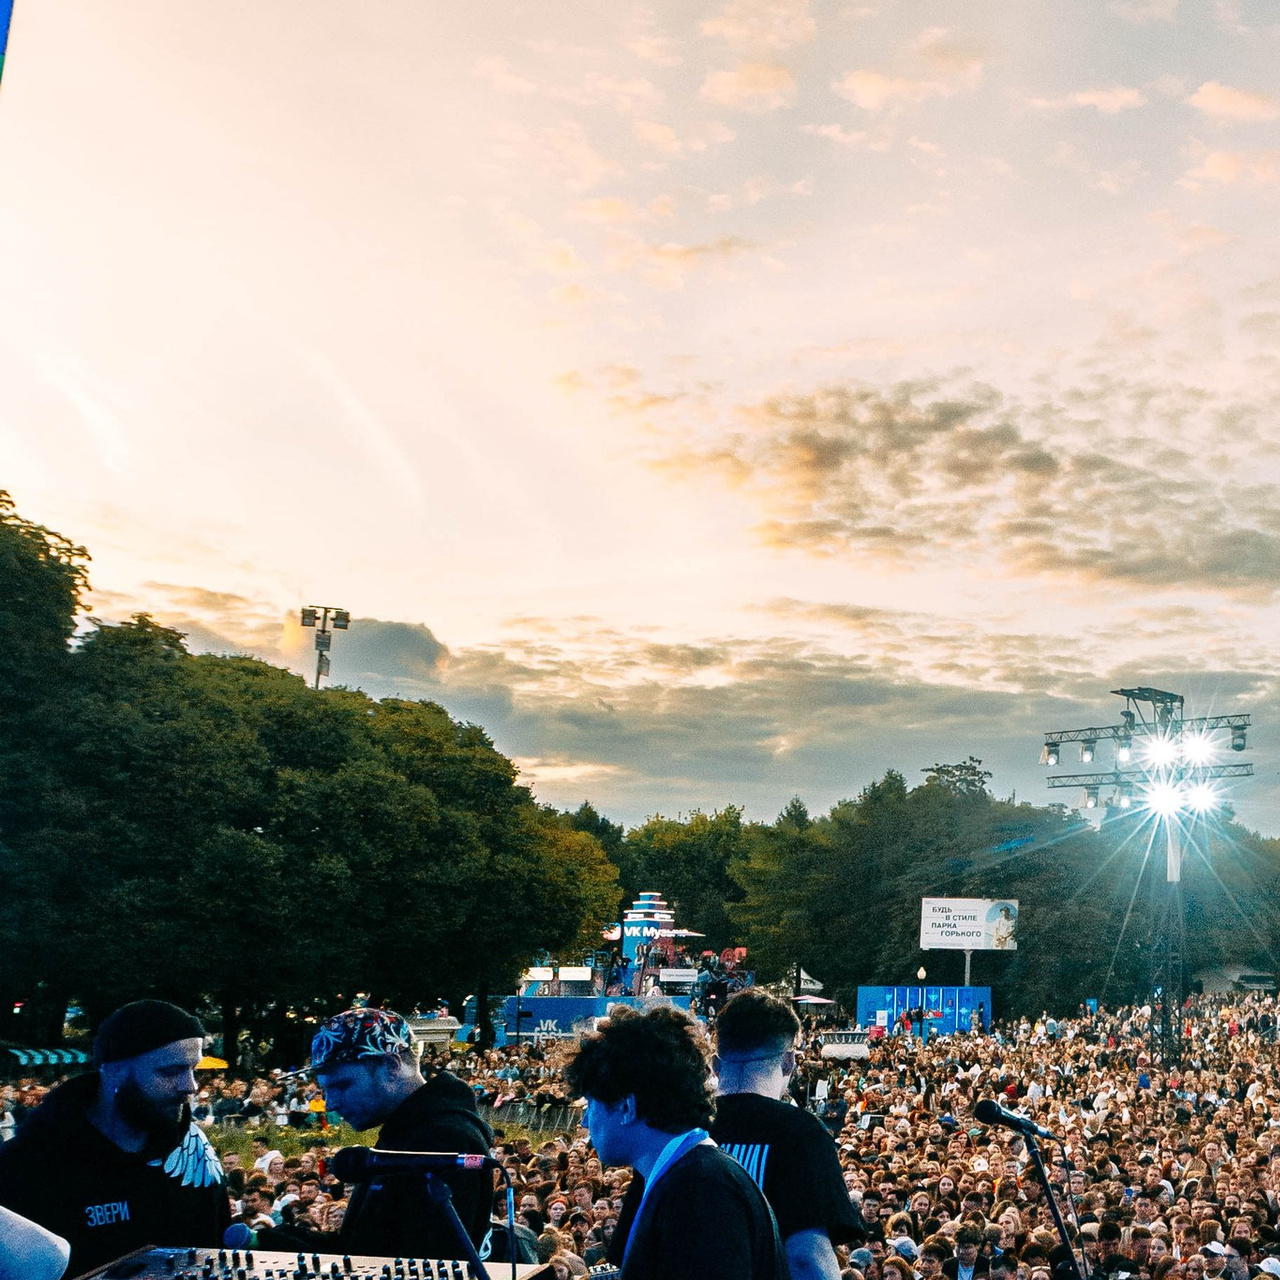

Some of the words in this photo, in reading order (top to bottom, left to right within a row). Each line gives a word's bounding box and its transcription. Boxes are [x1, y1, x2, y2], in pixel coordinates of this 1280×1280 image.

[932, 906, 953, 914] БУДЬ
[623, 926, 641, 937] VK
[940, 930, 982, 938] ГОРЬКОГО
[539, 1018, 558, 1032] VK
[84, 1200, 130, 1227] ЗВЕРИ
